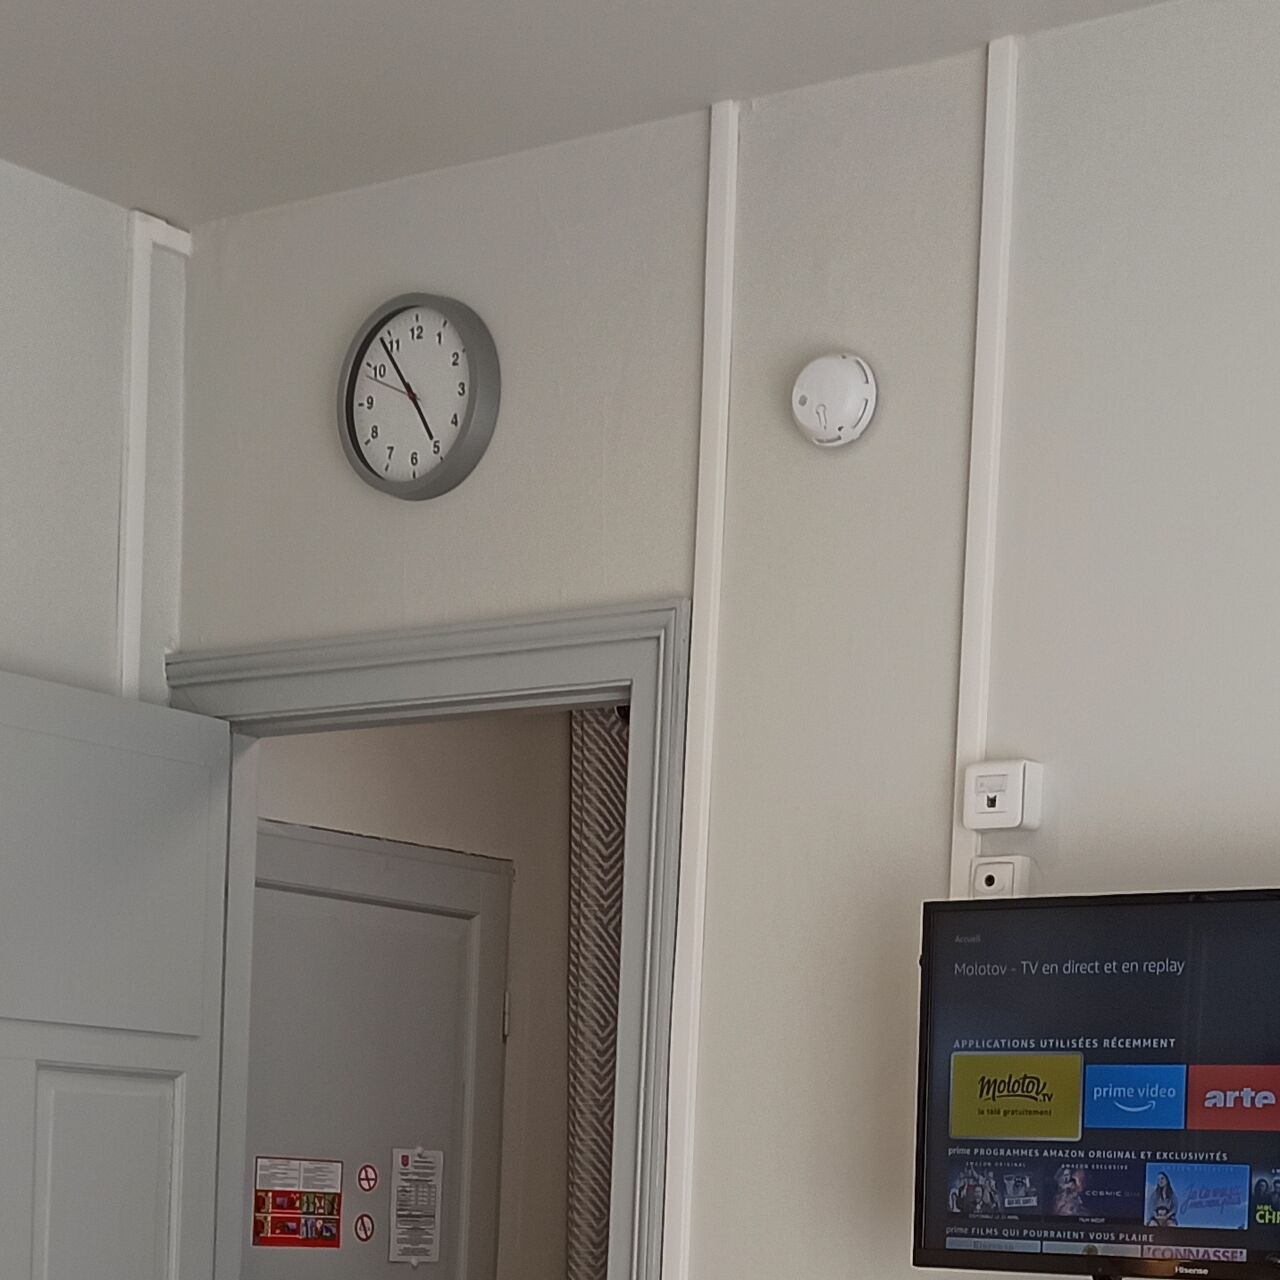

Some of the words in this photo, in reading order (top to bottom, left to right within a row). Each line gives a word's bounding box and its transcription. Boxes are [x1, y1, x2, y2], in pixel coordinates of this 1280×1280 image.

[409, 325, 424, 341] 12
[436, 331, 442, 345] 1
[389, 339, 401, 352] 11
[451, 352, 460, 366] 2
[373, 364, 387, 378] 10
[457, 382, 466, 397] 3
[366, 395, 374, 410] 9
[450, 413, 459, 427] 4
[371, 425, 379, 439] 8
[386, 446, 395, 460] 7
[432, 440, 441, 455] 5
[410, 452, 418, 467] 6
[953, 961, 1007, 976] Molotov
[1020, 960, 1039, 975] TV
[1041, 963, 1059, 974] en
[1062, 959, 1100, 975] direct
[1103, 961, 1117, 974] et
[1121, 961, 1139, 973] en
[1143, 958, 1186, 976] replay
[953, 1038, 1036, 1049] APPLICATIONS
[1040, 1036, 1099, 1048] UTILISÉES
[1103, 1035, 1176, 1048] RÉCEMMENT
[1092, 1083, 1134, 1101] prime
[1138, 1083, 1177, 1099] video
[1204, 1087, 1277, 1108] arte
[1002, 1107, 1052, 1117] gratuitement
[947, 1145, 971, 1157] prime
[973, 1147, 1040, 1158] PROGRAMMES
[1042, 1149, 1085, 1158] AMAZON
[1088, 1150, 1137, 1160] ORIGINAL
[1140, 1151, 1152, 1160] ET
[1156, 1150, 1228, 1161] EXCLUSIVITÉS
[1084, 1189, 1122, 1198] COSMIC
[945, 1226, 969, 1236] prime
[971, 1227, 999, 1236] FILMS
[1002, 1228, 1020, 1237] QUI
[1023, 1229, 1085, 1240] POURRAIENT
[1088, 1231, 1116, 1241] VOUS
[1118, 1232, 1155, 1243] PLAIRE
[1175, 1266, 1209, 1275] Hisense
